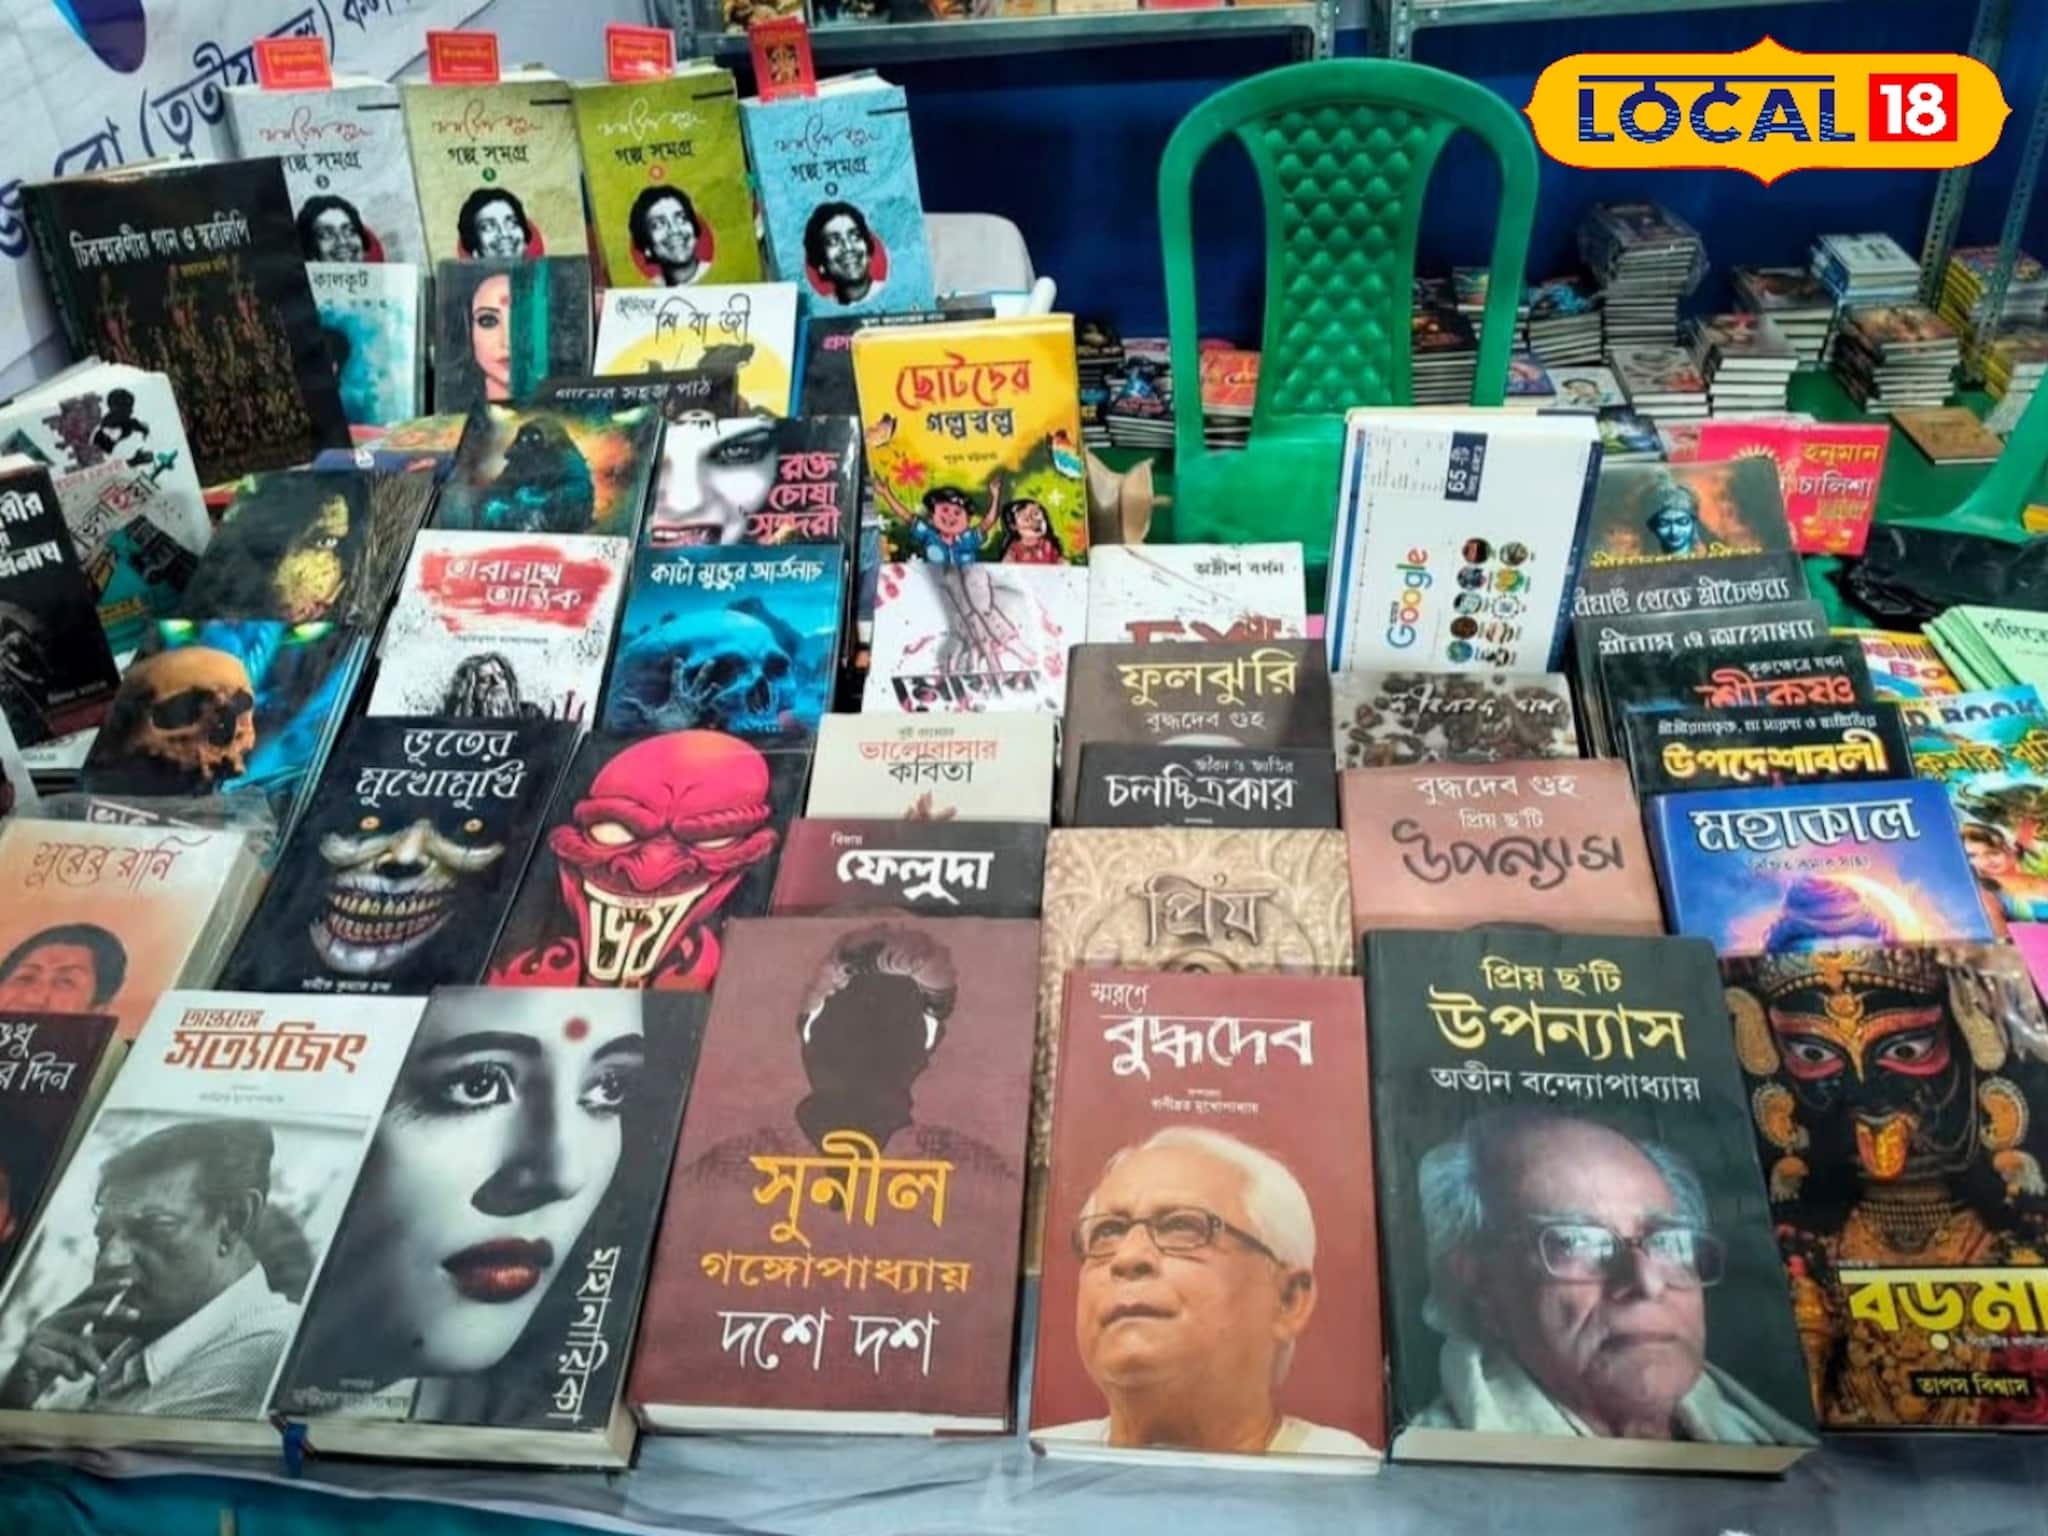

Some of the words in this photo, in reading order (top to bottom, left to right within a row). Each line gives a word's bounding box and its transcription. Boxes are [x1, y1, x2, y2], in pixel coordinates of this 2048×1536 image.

[315, 150, 362, 170] সমগ্র
[448, 145, 478, 167] গল্প
[482, 142, 530, 164] সমগ্র
[614, 145, 645, 167] গল্প
[648, 140, 694, 159] সমগ্র
[791, 161, 821, 183] গল্প
[825, 156, 869, 177] সমগ্র
[651, 557, 695, 586] কাটা
[1386, 547, 1433, 648] Google
[1635, 588, 1693, 612] থেকে
[1115, 647, 1299, 706] ফুলঝুরি
[1145, 711, 1220, 732] বুদ্ধদেব
[1228, 710, 1267, 729] গুহ
[401, 728, 520, 764] ভূতের
[858, 739, 1000, 761] ভালোবাসার
[1661, 729, 1890, 780] উপদেশাবলী
[355, 758, 528, 811] মুখোমুখি
[888, 754, 975, 785] কবিতা
[1104, 763, 1298, 811] চলচ্চিত্রকার
[1411, 774, 1519, 805] বুদ্ধদেব
[1528, 773, 1580, 798] গুহ
[1688, 797, 1922, 854] মহাকাল
[1391, 818, 1625, 890] উপন্যাস
[835, 849, 995, 906] ফেলুদা
[1478, 954, 1545, 993] প্রিয়
[1426, 983, 1688, 1062] উপন্যাস
[163, 1020, 368, 1075] সত্যজিৎ
[1098, 1014, 1315, 1081] বুদ্ধদেব
[20, 1051, 79, 1093] দিন
[1429, 1058, 1512, 1095] অতীন
[1518, 1069, 1702, 1103] বন্দ্যোপাধ্যায়
[749, 1129, 956, 1249] সুনীল
[700, 1249, 972, 1294] গঙ্গোপাধ্যায়
[546, 1245, 622, 1424] মহানায়িকা
[716, 1307, 833, 1371] দশে
[848, 1310, 941, 1378] দশ
